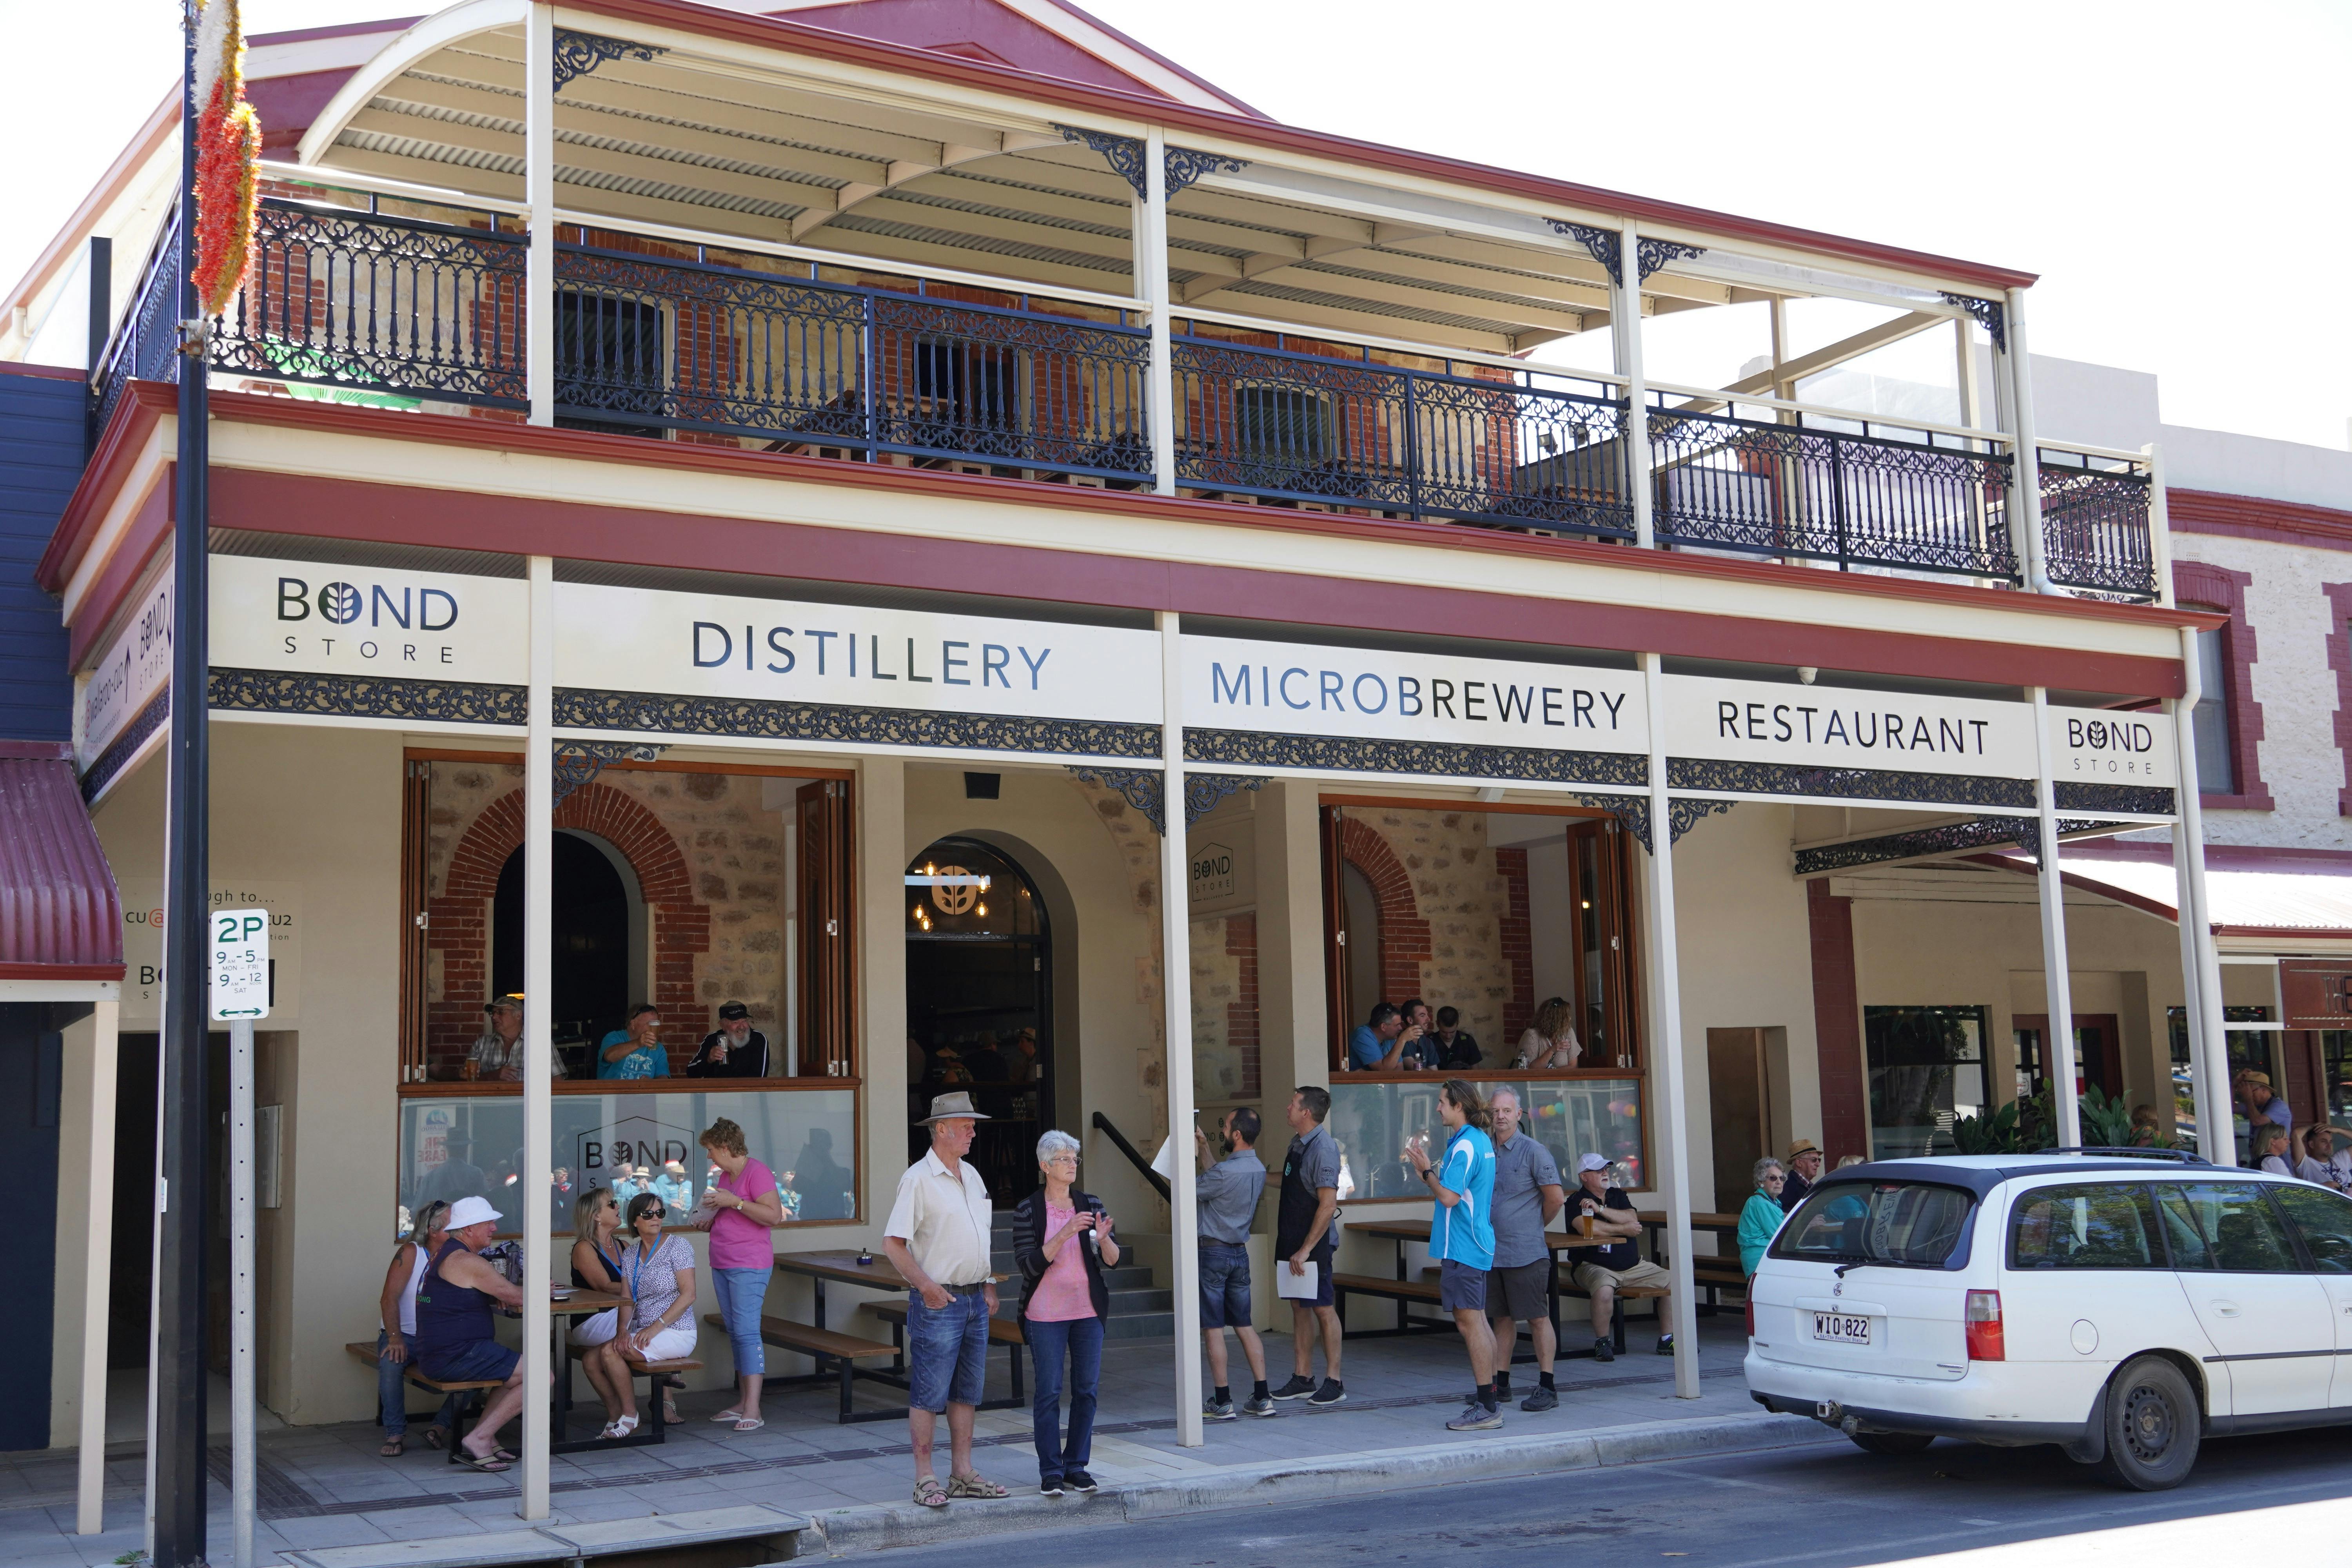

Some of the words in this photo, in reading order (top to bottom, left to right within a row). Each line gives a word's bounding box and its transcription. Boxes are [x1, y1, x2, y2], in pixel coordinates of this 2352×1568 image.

[278, 577, 458, 631] BOND
[140, 592, 166, 661] BOND
[285, 636, 452, 664] STORE
[693, 621, 1051, 690] DISTILLERY
[140, 648, 164, 690] STORE
[1212, 662, 1626, 730] MICROBREWERY
[1719, 701, 1988, 755] RESTAURANT
[2068, 719, 2152, 752] BOND
[2074, 758, 2152, 774] STORE
[1194, 856, 1230, 880] BOND
[1196, 879, 1229, 893] STORE
[218, 916, 263, 943] 2P
[216, 952, 226, 964] 9
[246, 950, 255, 962] 5
[220, 974, 229, 987] 9
[250, 973, 261, 982] 12
[1204, 1132, 1216, 1142] ND
[586, 1140, 687, 1169] BOND
